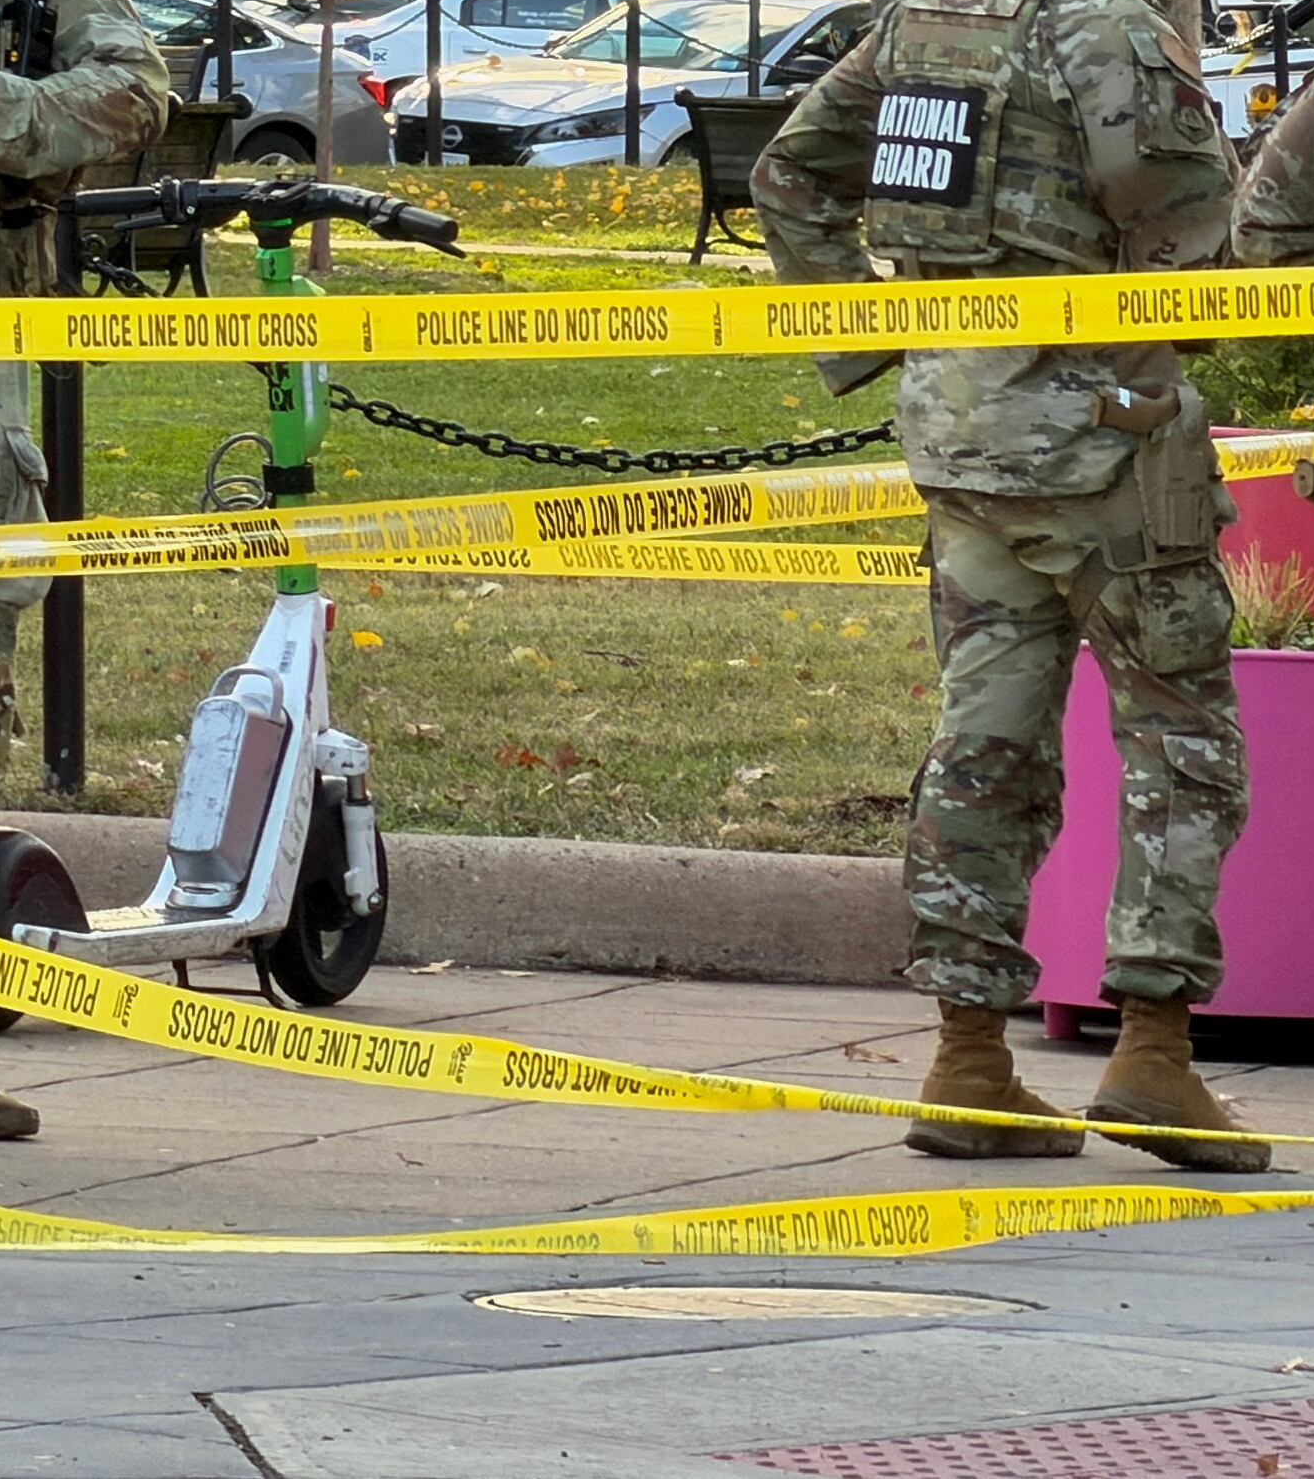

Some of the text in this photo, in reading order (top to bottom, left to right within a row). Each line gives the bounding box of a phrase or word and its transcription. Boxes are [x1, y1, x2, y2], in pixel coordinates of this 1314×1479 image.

[872, 143, 953, 190] GUARD
[767, 294, 1018, 337] POLICE LINE DO NOT CROSS
[1118, 288, 1183, 325] POLICE
[1189, 287, 1229, 322] LINE
[1235, 285, 1260, 320] DO
[1266, 283, 1302, 318] NOT
[68, 313, 317, 348] POLICE LINE DO NOT CROSS
[417, 305, 668, 346] POLICE LINE DO NOT CROSS
[534, 482, 752, 542] CRIME SCENE DO NOT CROSS
[27, 962, 101, 1019] POLICE
[168, 1000, 434, 1078] POLICE LINE DO NOT CROSS
[502, 1050, 568, 1091] CROSS
[570, 1059, 611, 1095] NOT
